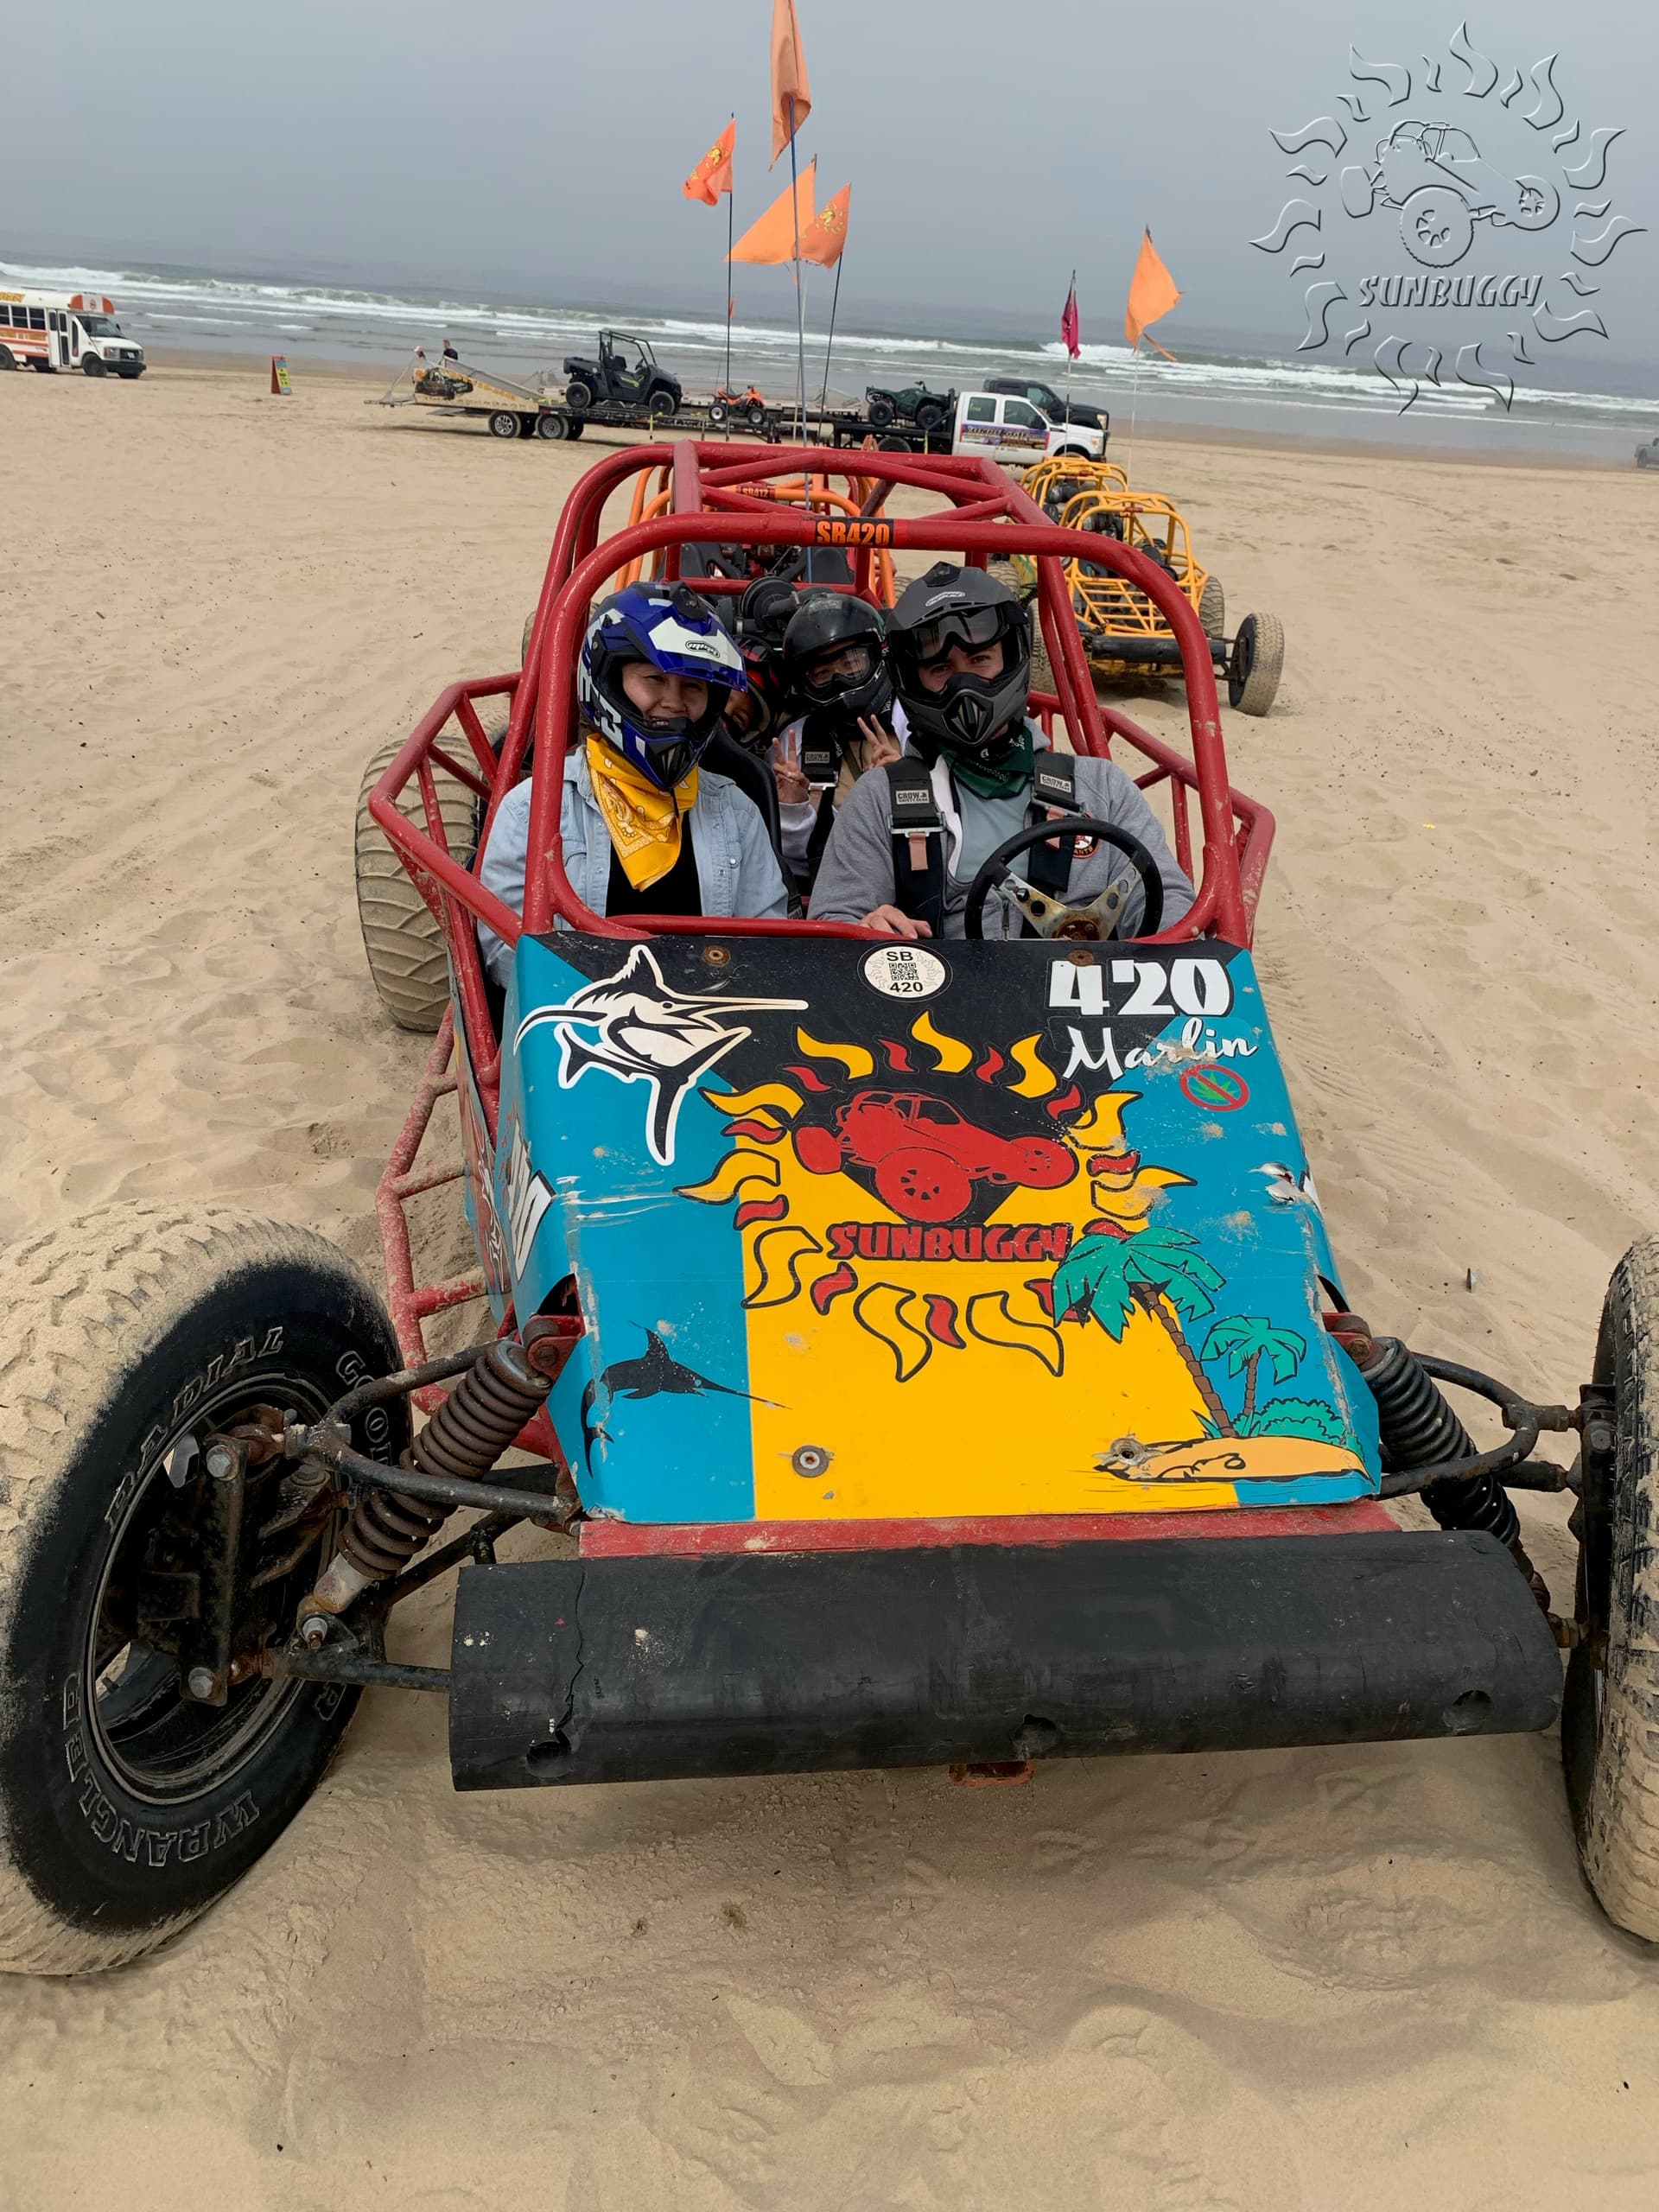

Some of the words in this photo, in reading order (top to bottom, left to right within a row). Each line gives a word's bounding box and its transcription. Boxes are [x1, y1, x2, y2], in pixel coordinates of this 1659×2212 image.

[817, 520, 891, 546] SB420
[887, 951, 913, 962] SB
[889, 982, 924, 993] 420
[1048, 958, 1230, 1016] 420
[1062, 1016, 1258, 1081] Marlin
[828, 1224, 1071, 1261] SUNBUGGY
[104, 1325, 284, 1535] RADIAL
[63, 1671, 260, 1867] WRANGLER
